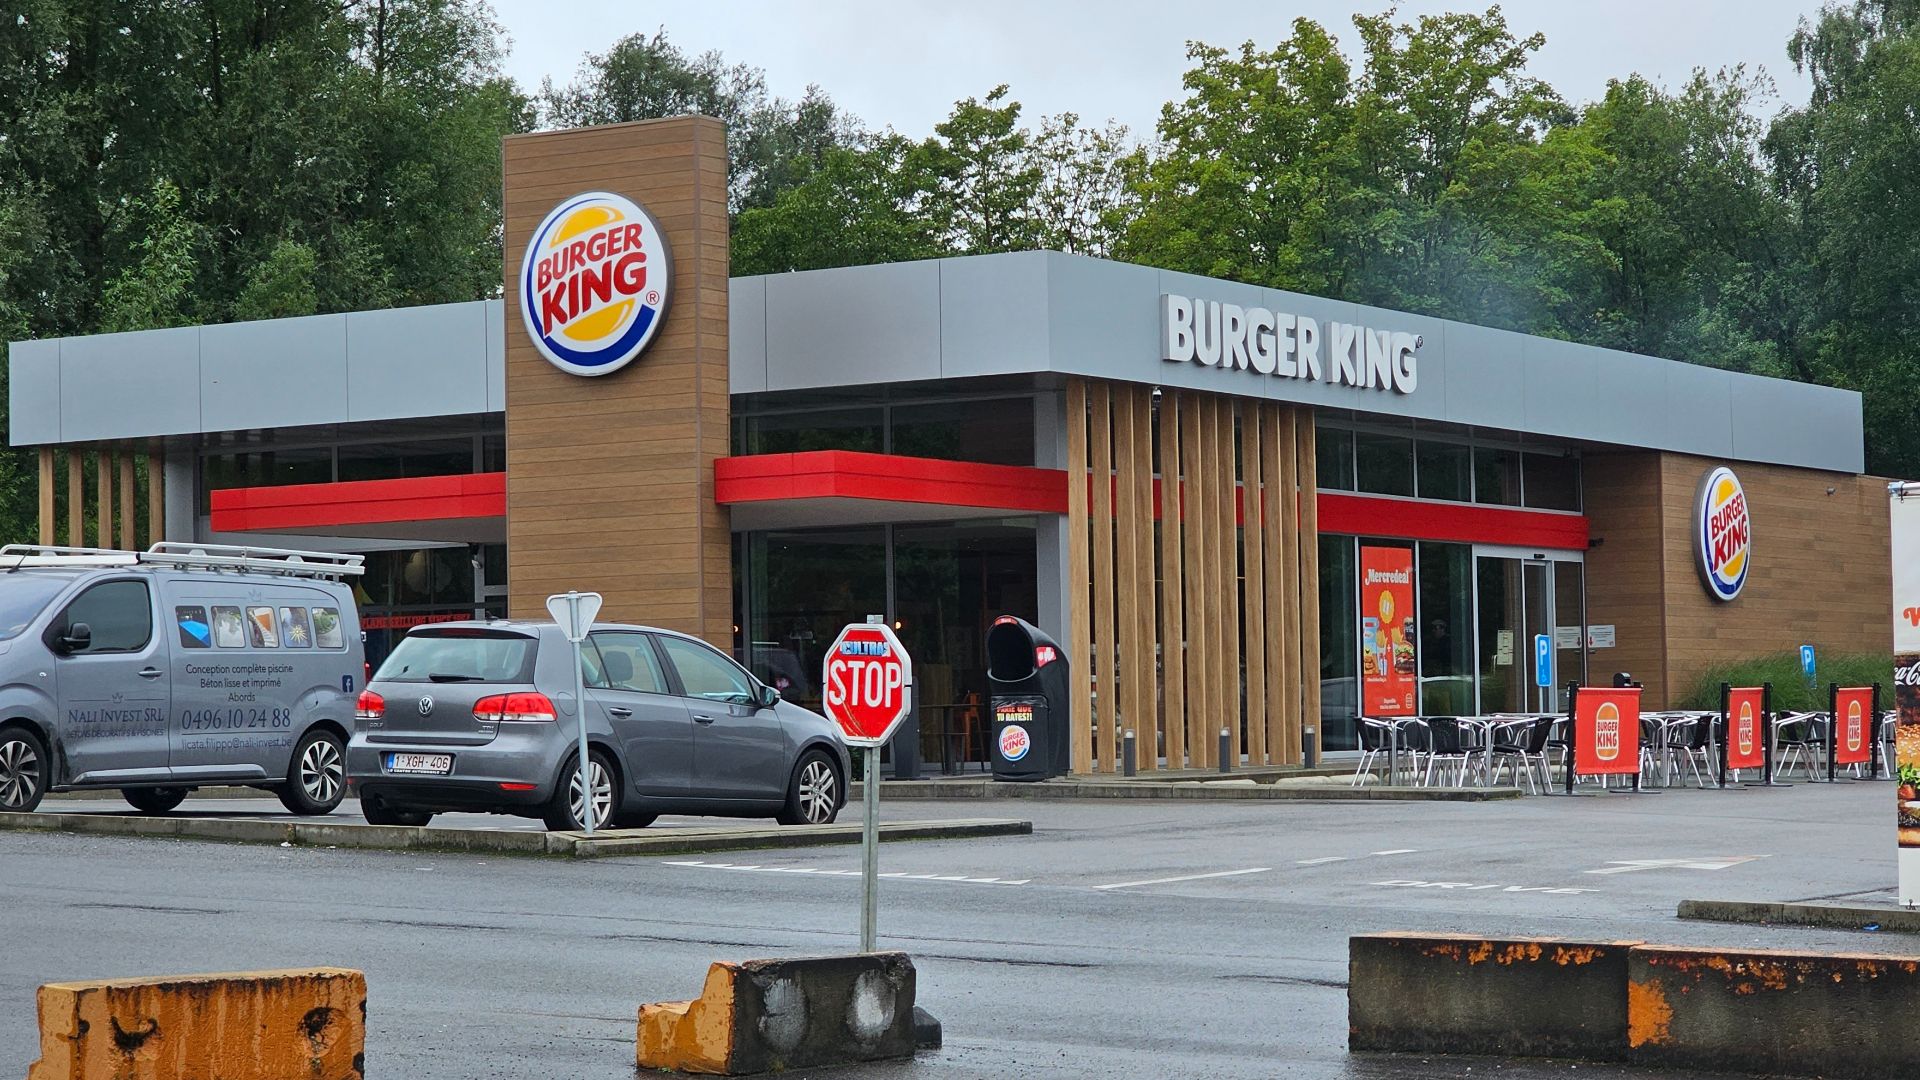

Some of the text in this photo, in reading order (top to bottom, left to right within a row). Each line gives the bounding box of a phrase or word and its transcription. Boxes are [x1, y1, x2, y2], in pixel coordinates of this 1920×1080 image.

[537, 223, 643, 294] BURGER
[542, 252, 647, 337] KING
[1162, 293, 1418, 394] BURGER KING
[1711, 493, 1744, 540] BURGER
[1713, 513, 1748, 572] KING
[1365, 568, 1409, 585] Mercredeal
[185, 664, 294, 677] Conception complète piscine
[200, 678, 282, 690] Béton lisse et imprimé
[828, 659, 902, 708] STOP
[228, 692, 256, 702] Abords
[68, 707, 165, 723] NALI INVEST SRL
[181, 708, 291, 730] 0496 10 24 88
[1597, 721, 1618, 732] BURGER
[1848, 726, 1860, 740] KING
[1002, 731, 1025, 744] BURGER
[1597, 732, 1617, 748] KING
[1740, 728, 1752, 744] KING
[1003, 738, 1026, 752] KING
